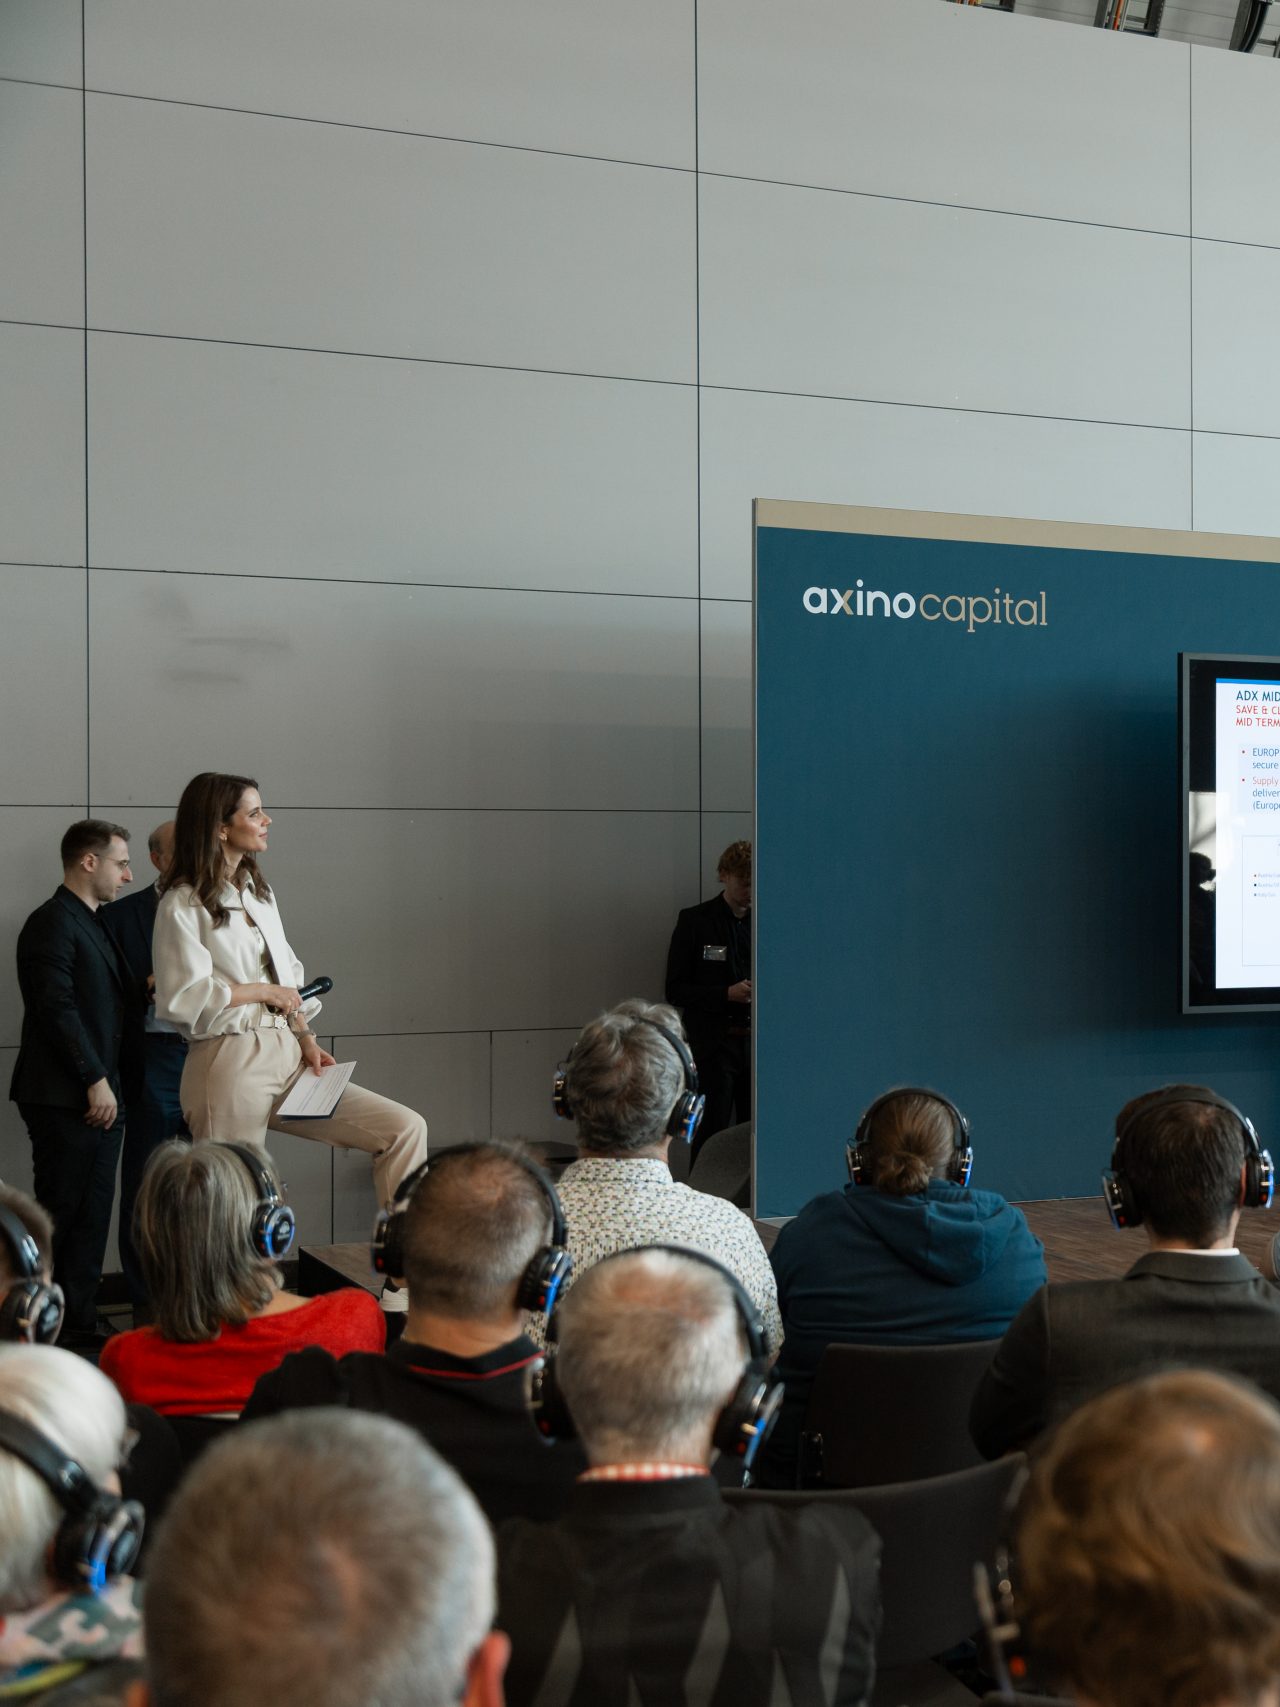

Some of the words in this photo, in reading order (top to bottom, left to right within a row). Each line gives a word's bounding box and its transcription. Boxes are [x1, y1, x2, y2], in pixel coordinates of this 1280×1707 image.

[1236, 690, 1259, 701] ADX
[1236, 704, 1259, 715] SAVE
[1261, 705, 1268, 715] &
[1235, 717, 1253, 727] MID
[1256, 718, 1280, 728] TERM
[1252, 762, 1279, 770] secure
[1252, 776, 1279, 787] Supply
